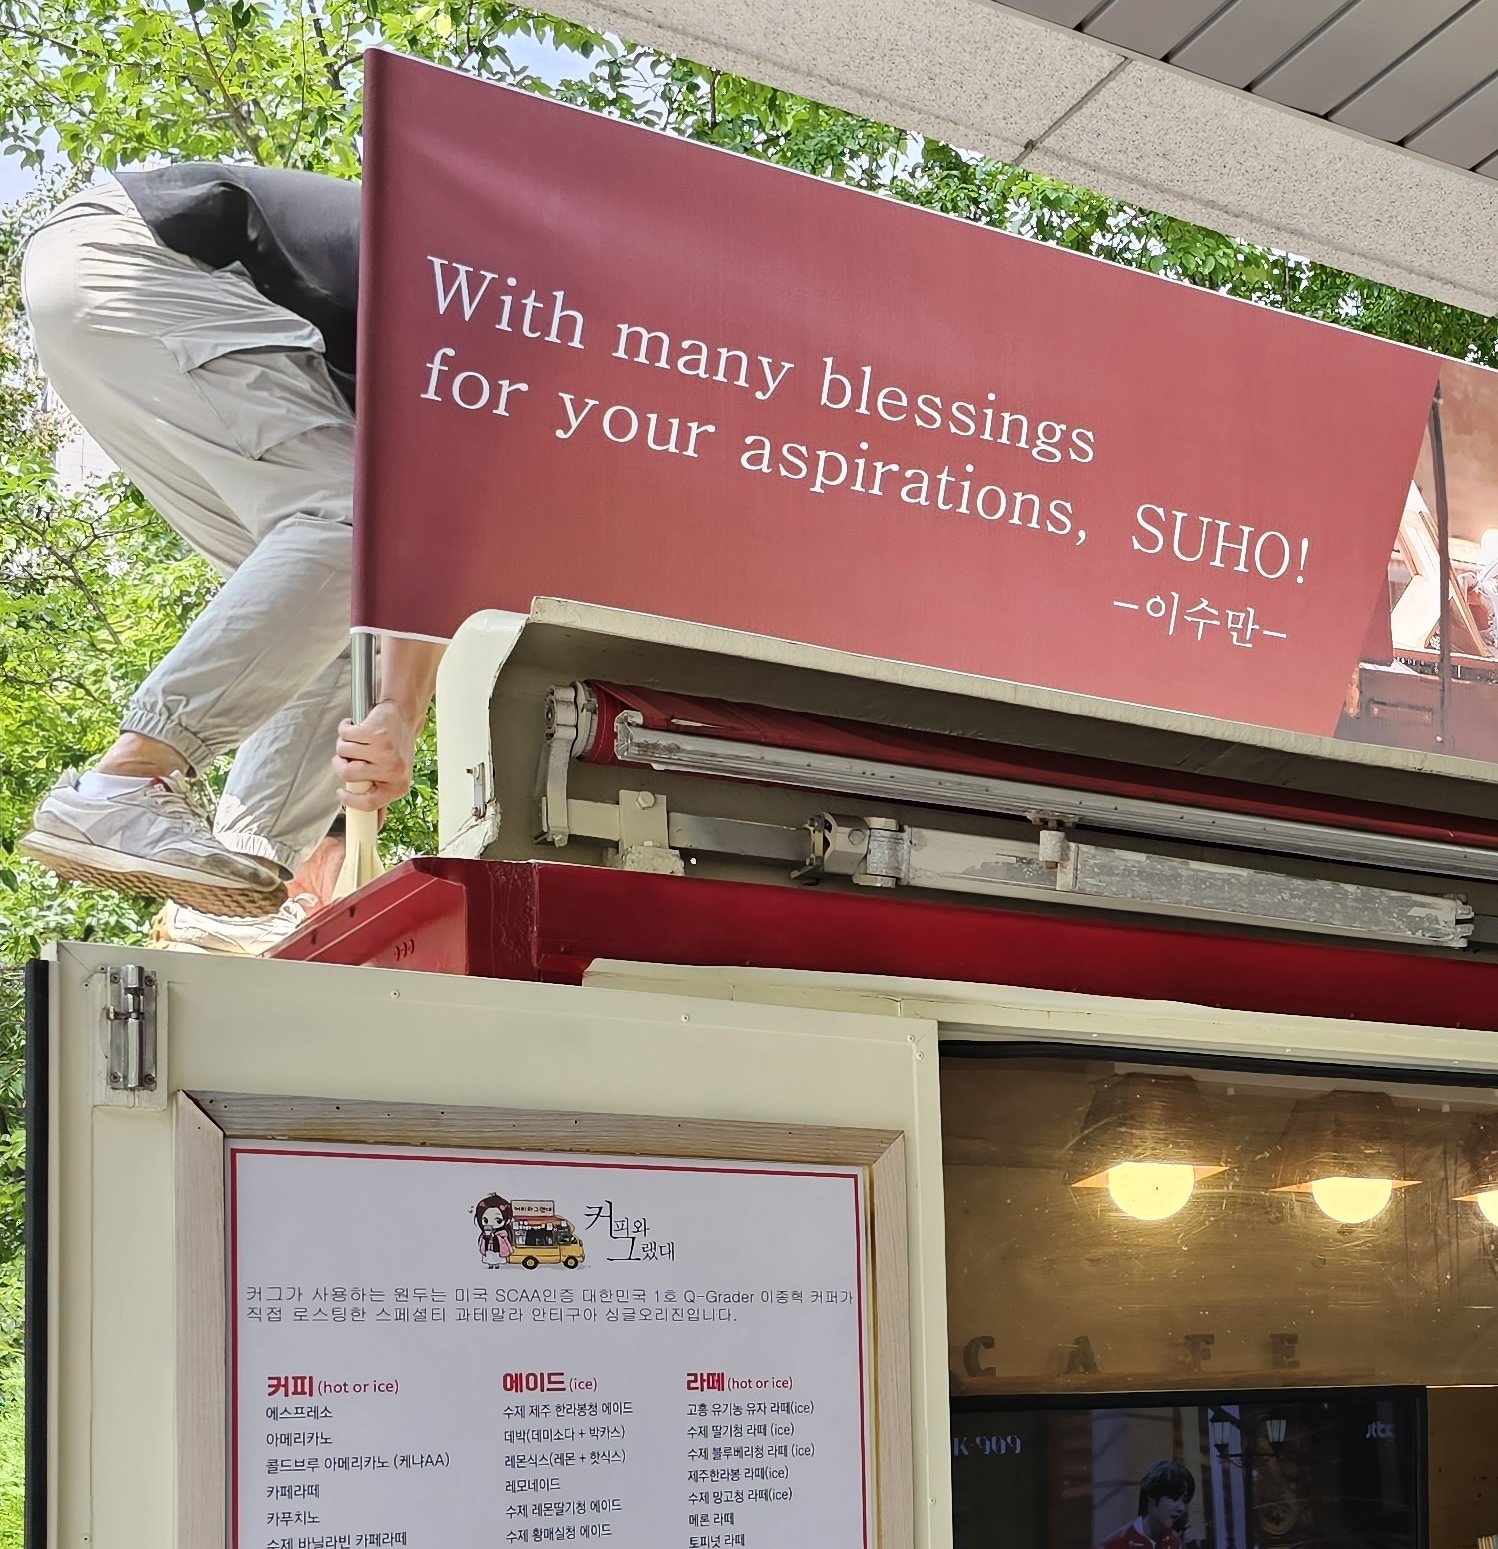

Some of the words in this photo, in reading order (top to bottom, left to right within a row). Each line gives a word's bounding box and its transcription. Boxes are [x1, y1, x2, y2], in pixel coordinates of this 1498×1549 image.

[427, 255, 585, 349] With
[611, 323, 796, 400] many
[820, 356, 1095, 465] blessings
[420, 347, 529, 418] for
[555, 392, 716, 459] your
[740, 435, 1087, 547] aspirations,
[1131, 503, 1310, 584] SUHO!
[247, 1286, 303, 1302] 커그가
[312, 1286, 385, 1302] 사용하는
[394, 1287, 447, 1303] 원두는
[455, 1287, 488, 1302] 미국
[495, 1288, 574, 1303] SCAA인증
[582, 1288, 646, 1303] 대한민국
[654, 1289, 677, 1303] 1호
[683, 1289, 755, 1304] Q-Grader
[247, 1306, 281, 1322] 직접
[292, 1306, 366, 1322] 로스팅한
[531, 1307, 597, 1322] 안티구아
[605, 1307, 737, 1322] 싱글오리진입니다.
[267, 1375, 314, 1398] 커피
[317, 1380, 349, 1396] (hot
[352, 1383, 370, 1393] or
[372, 1378, 399, 1395] ice)
[502, 1371, 567, 1393] 에이드
[569, 1376, 597, 1393] (ice)
[686, 1371, 725, 1392] 라떼
[727, 1377, 753, 1392] (hot
[755, 1379, 769, 1389] or
[771, 1376, 793, 1390] ice)
[265, 1405, 333, 1421] 에스프레소
[265, 1431, 333, 1447] 아메리카노
[265, 1457, 320, 1474] 콜드브루
[324, 1455, 390, 1472] 아메리카노
[393, 1451, 450, 1469] (케냐AA)
[266, 1483, 320, 1500] 카페라떼
[505, 1477, 561, 1494] 레모네이드
[505, 1503, 528, 1519] 수제
[531, 1499, 586, 1517] 레몬딸기청
[589, 1498, 622, 1513] 에이드
[267, 1510, 320, 1527] 카푸치노
[713, 1511, 734, 1526] 라떼
[355, 1531, 407, 1548] 카페라떼
[505, 1528, 529, 1544] 수제
[531, 1525, 576, 1543] 황매실청
[579, 1523, 612, 1538] 에이드
[688, 1534, 721, 1549] 토피넛
[724, 1533, 745, 1547] 라떼
